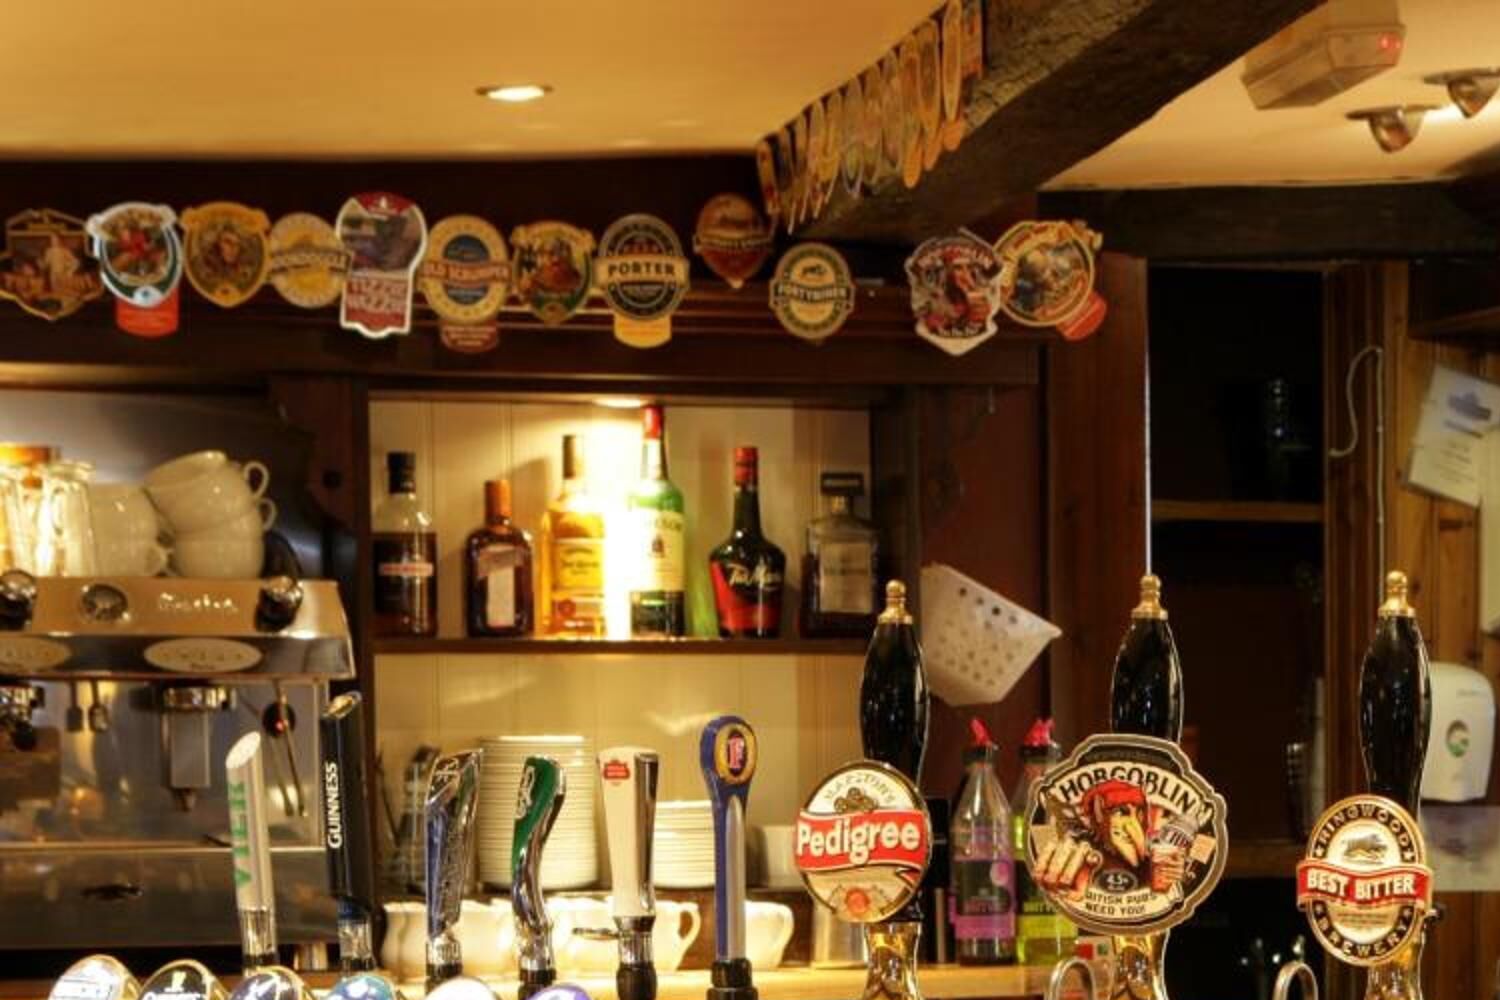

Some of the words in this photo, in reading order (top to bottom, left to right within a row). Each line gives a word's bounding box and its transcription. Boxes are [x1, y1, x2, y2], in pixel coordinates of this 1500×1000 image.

[607, 261, 676, 276] PORTER
[325, 762, 344, 849] GUINNESS
[1318, 803, 1411, 846] RINGWOOD
[797, 817, 920, 865] Pedigree
[1306, 868, 1350, 897] BEST
[1354, 873, 1416, 901] BITTER
[1318, 917, 1409, 956] BREWERY
